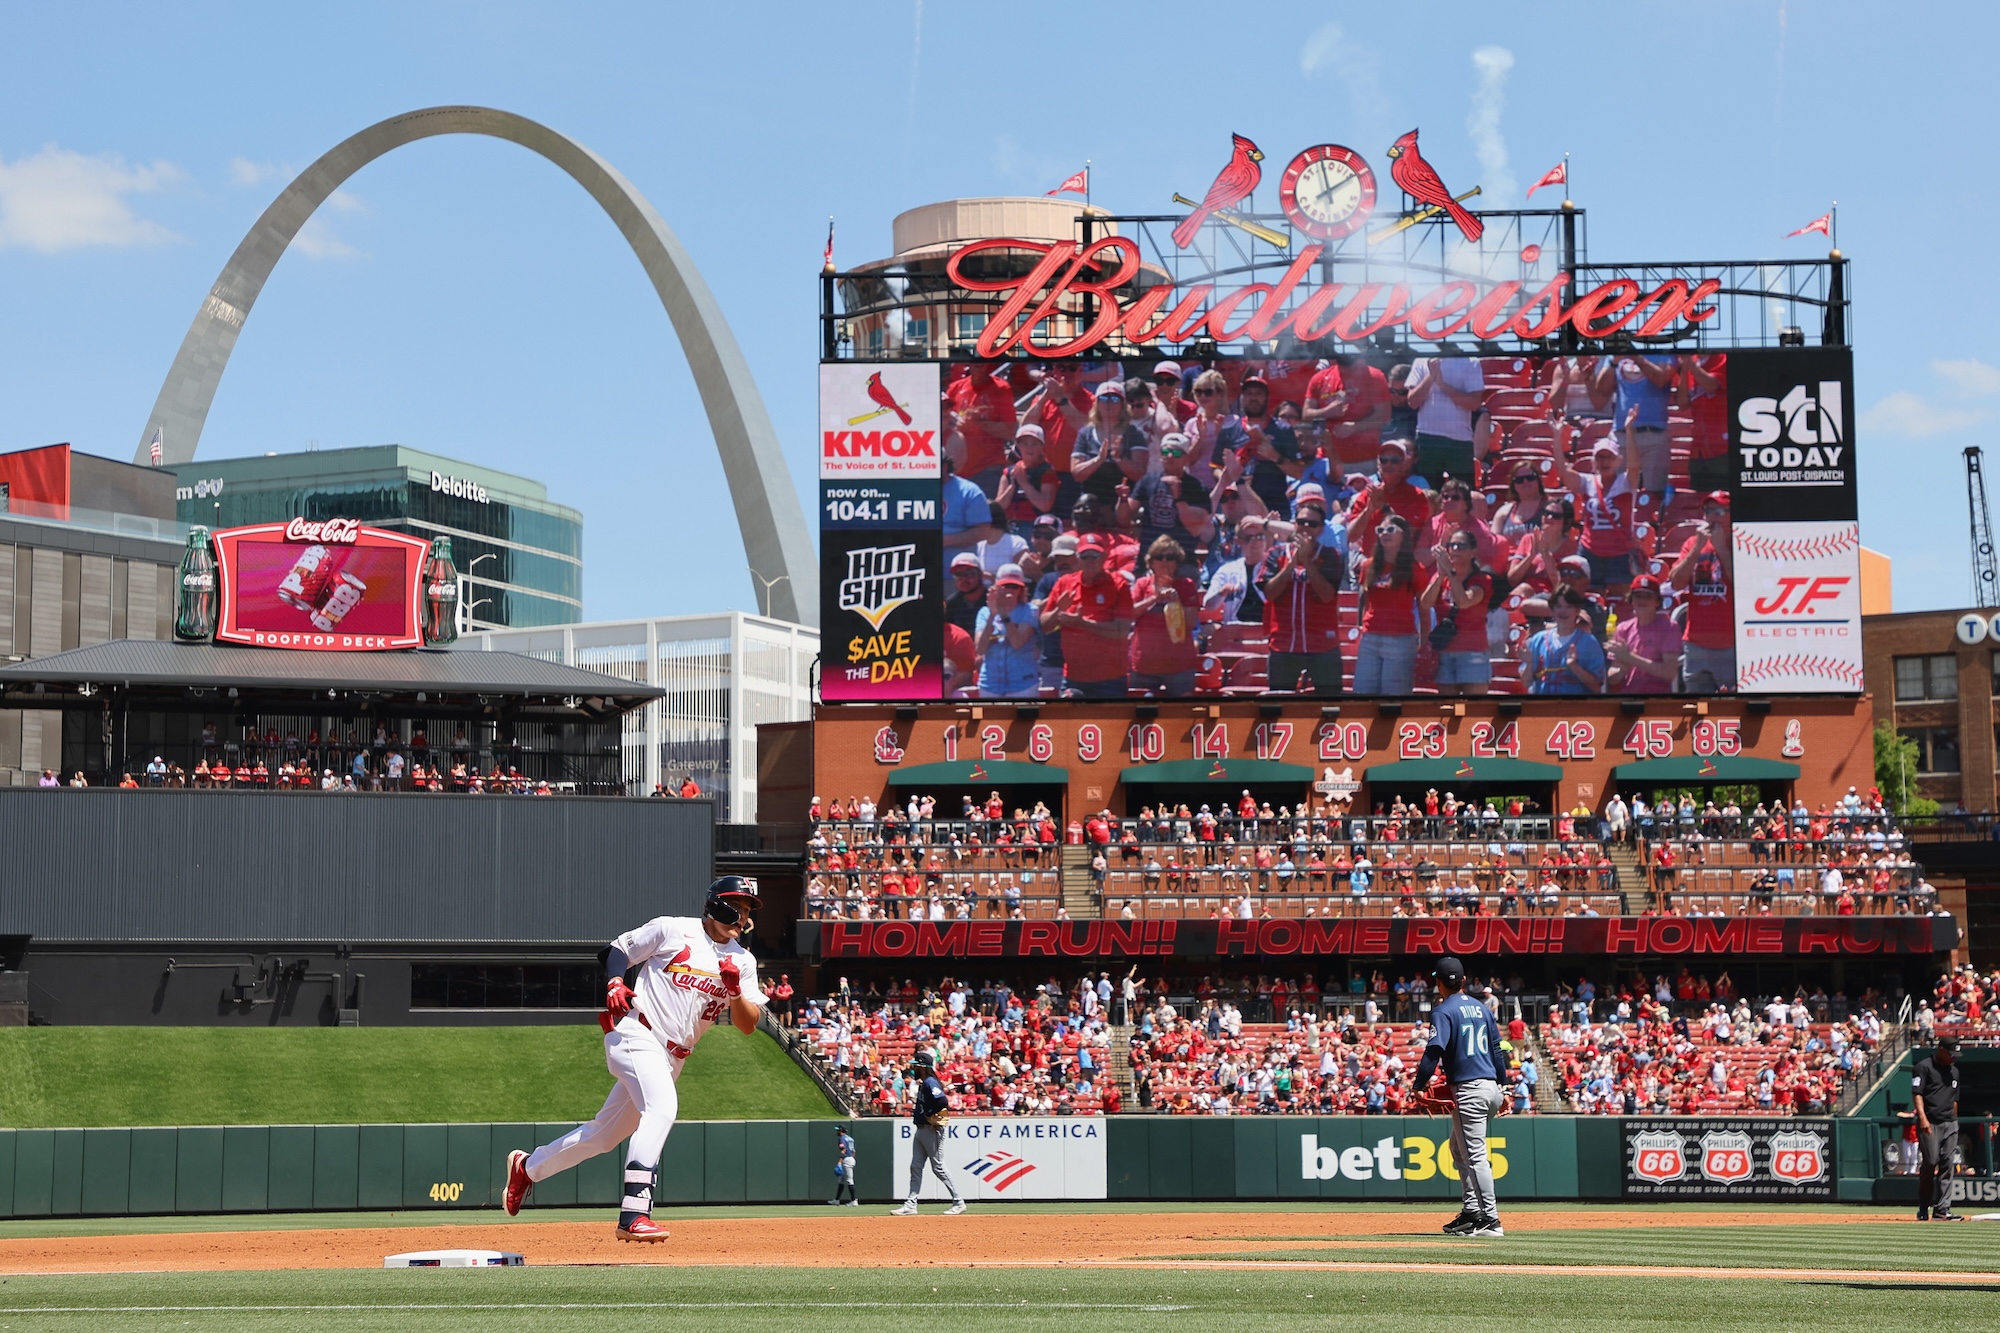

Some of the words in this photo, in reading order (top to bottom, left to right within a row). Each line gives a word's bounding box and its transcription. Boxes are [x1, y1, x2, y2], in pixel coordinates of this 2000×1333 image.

[946, 236, 1721, 358] Budweiser
[824, 430, 936, 457] KMOX
[1740, 447, 1843, 468] TODAY
[824, 461, 843, 470] The
[846, 461, 875, 470] Voice
[878, 461, 889, 470] of
[892, 461, 906, 470] St.
[909, 461, 937, 470] Louis
[1741, 471, 1753, 481] ST.
[1754, 471, 1779, 481] LOUIS
[1780, 470, 1845, 481] POST-DISPATCH
[431, 470, 490, 505] Deloitte.
[827, 489, 858, 498] now
[860, 488, 890, 498] on...
[826, 500, 889, 521] 104.1
[897, 500, 936, 520] FM
[848, 545, 915, 580] HOT
[840, 569, 924, 610] SHOT
[256, 633, 335, 646] ROOFTOP
[344, 635, 386, 648] DECK
[1746, 627, 1849, 638] ELECTRIC
[845, 667, 870, 680] THE
[871, 655, 921, 684] DAY
[944, 724, 958, 761] 1
[982, 725, 1006, 761] 2
[1029, 724, 1054, 761] 6
[1078, 724, 1102, 761] 9
[1128, 723, 1165, 761] 10
[1192, 723, 1229, 761] 14
[1256, 723, 1294, 760] 17
[1319, 722, 1367, 760] 20
[1400, 721, 1448, 759] 23
[1471, 721, 1520, 759] 24
[1546, 721, 1596, 758] 42
[1623, 720, 1674, 758] 45
[1693, 719, 1742, 757] 85
[667, 759, 719, 772] Gateway
[831, 921, 1006, 957] HOME
[1018, 919, 1176, 956] RUN!!
[1216, 919, 1393, 955] HOME
[1404, 917, 1566, 954] RUN!!
[1605, 917, 1786, 954] HOME
[1461, 1022, 1489, 1056] 76
[901, 1125, 959, 1138] BK
[967, 1125, 990, 1139] OF
[1000, 1124, 1097, 1138] AMERICA
[1640, 1139, 1678, 1149] PHILLIPS
[1708, 1139, 1746, 1149] PHILLIPS
[1777, 1139, 1816, 1149] PHILLIPS
[1642, 1151, 1676, 1172] 66
[1710, 1152, 1743, 1172] 66
[1780, 1153, 1814, 1172] 66
[429, 1183, 464, 1202] 400'
[1951, 1179, 2000, 1202] BUS
